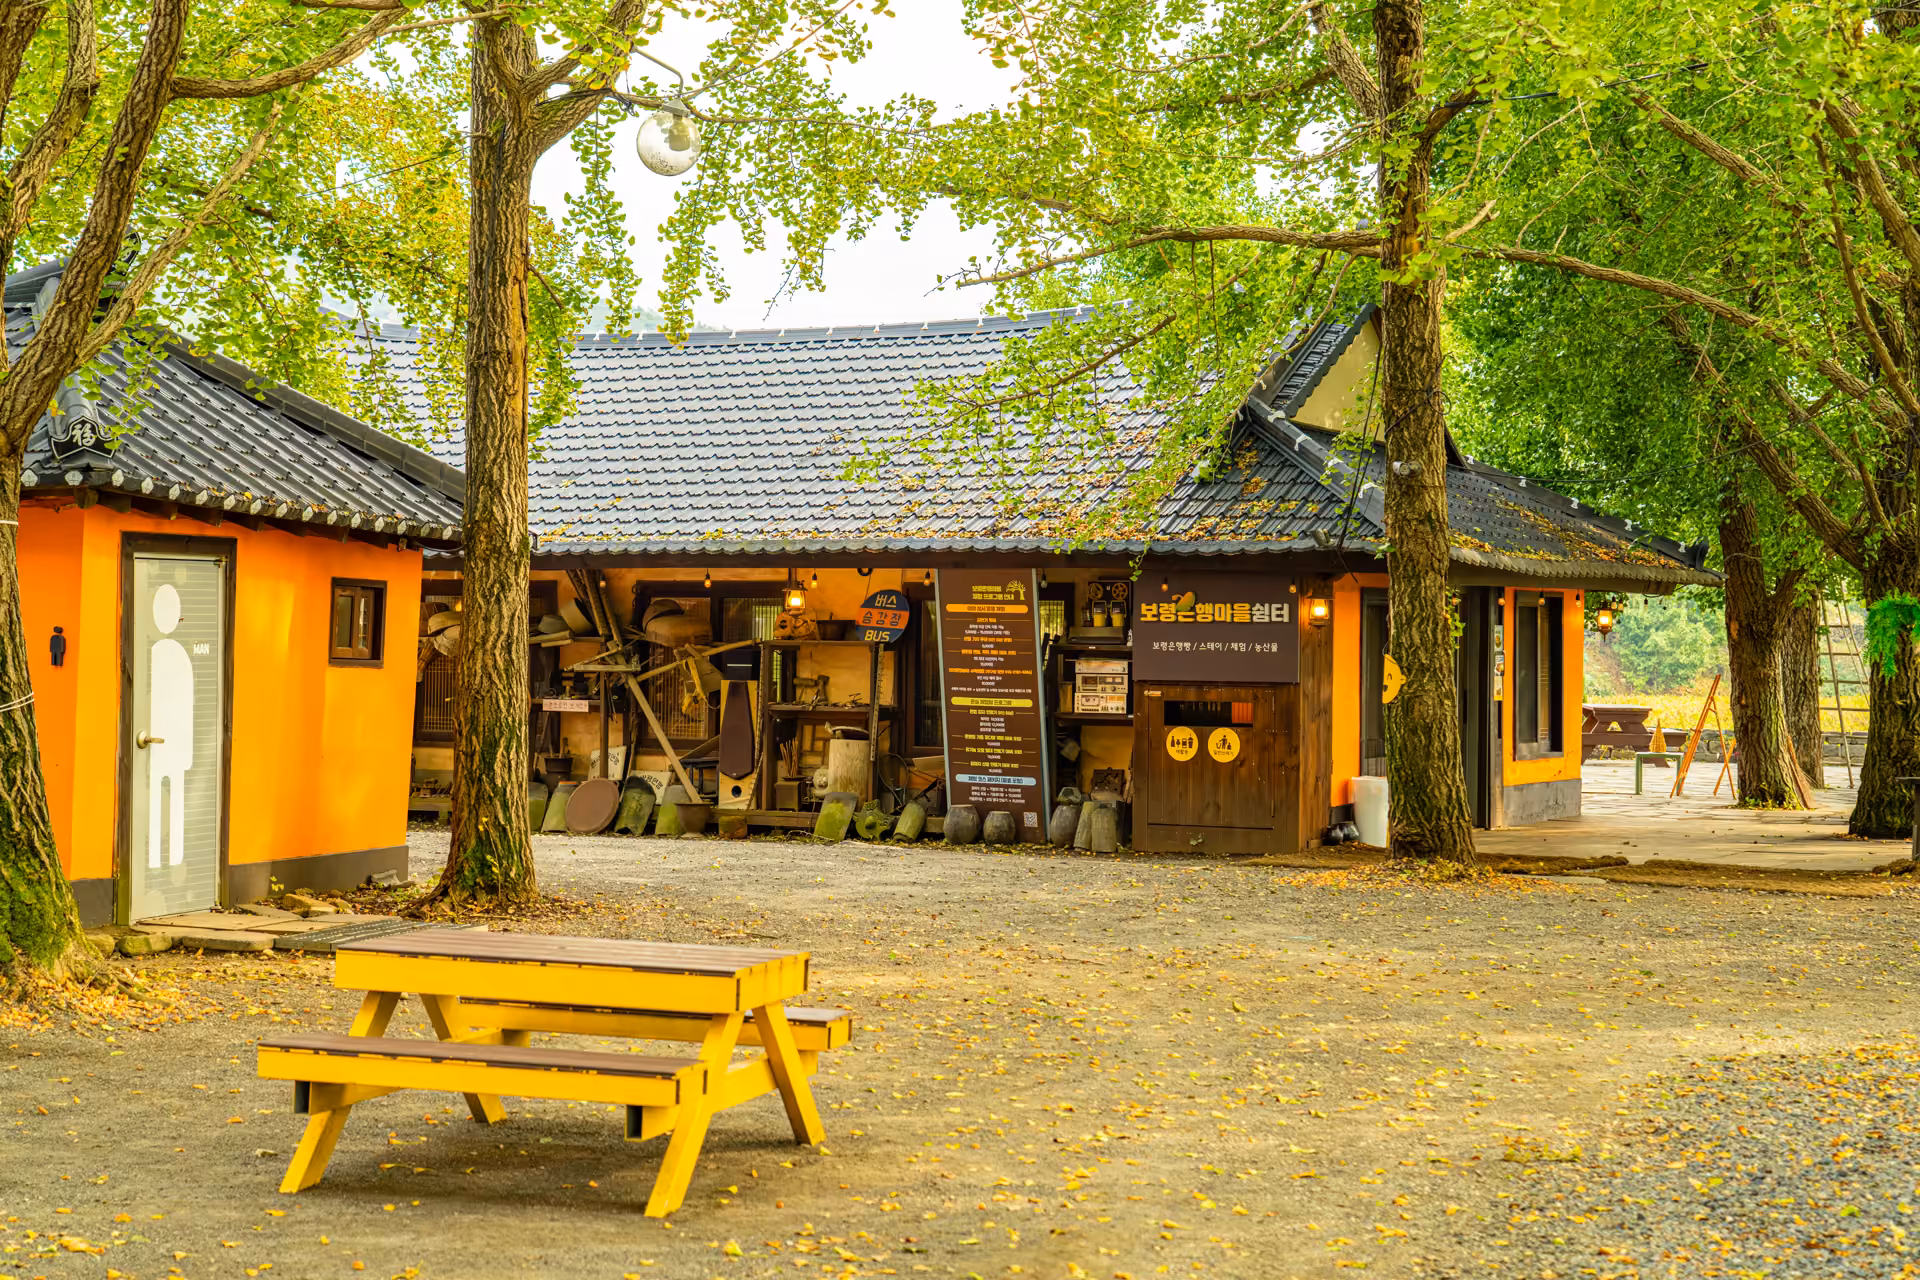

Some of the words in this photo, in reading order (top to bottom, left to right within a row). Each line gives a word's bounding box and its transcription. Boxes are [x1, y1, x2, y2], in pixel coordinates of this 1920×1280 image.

[875, 594, 896, 608] 버스
[862, 611, 901, 626] 승강장
[864, 630, 890, 642] BUS
[194, 643, 209, 655] MAN
[1152, 641, 1191, 652] 보령은행빵
[1199, 642, 1222, 651] 스테이
[1230, 643, 1246, 652] 체험
[1254, 642, 1278, 652] 농산물
